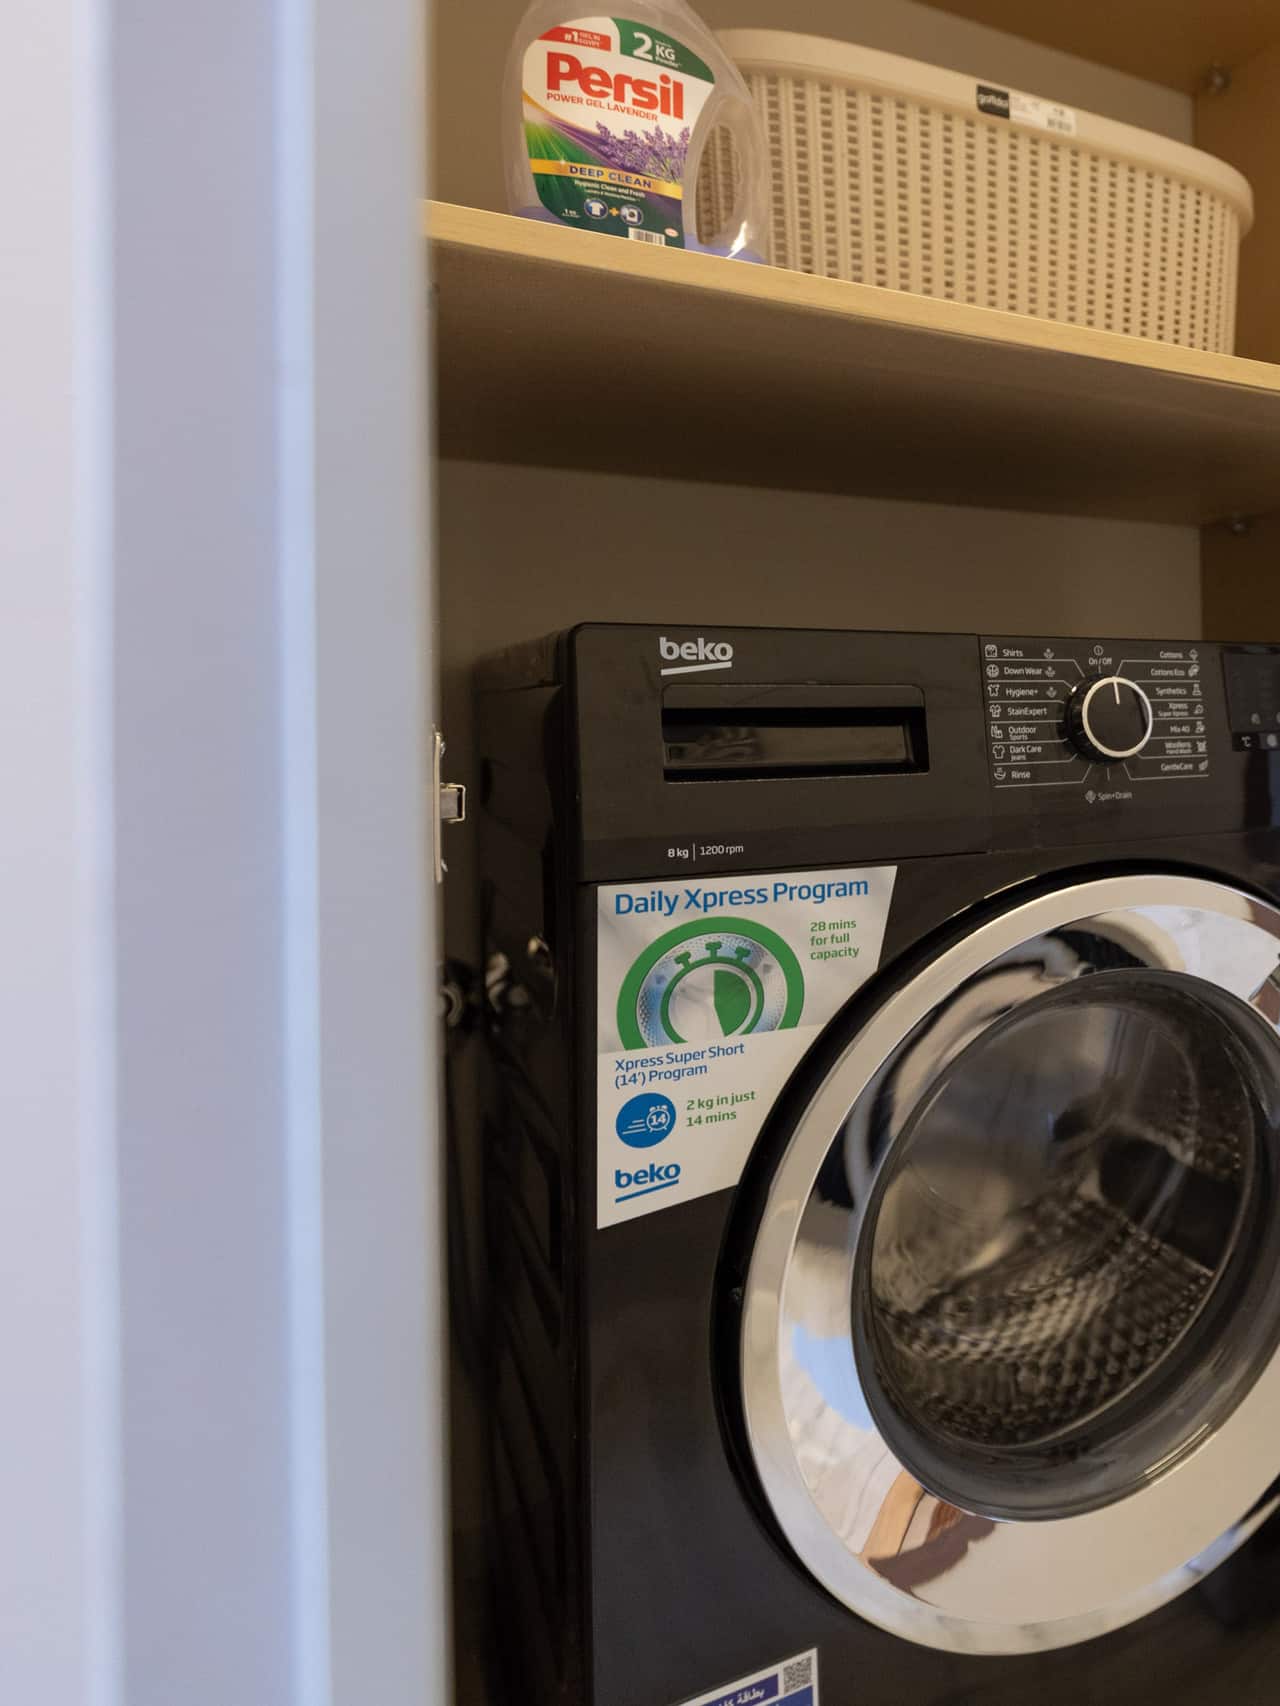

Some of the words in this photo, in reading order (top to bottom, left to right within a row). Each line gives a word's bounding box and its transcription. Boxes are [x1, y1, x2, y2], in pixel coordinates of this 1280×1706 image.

[633, 31, 653, 61] 2
[655, 44, 676, 61] KG
[546, 51, 684, 120] Persil
[546, 92, 584, 105] POWER
[586, 98, 605, 110] GEL
[607, 103, 658, 122] LAVENDER
[569, 165, 605, 178] DEEP
[608, 172, 652, 189] CLEAN
[659, 637, 734, 661] beko
[1002, 648, 1024, 657] Shirts
[1160, 650, 1183, 659] Cottons
[1102, 657, 1112, 665] Off
[1003, 666, 1024, 675] Down
[1024, 666, 1042, 675] Wear
[1005, 688, 1039, 697] Hygiene+
[1155, 687, 1188, 696] Synthetics
[1007, 707, 1048, 717] StainExpert
[1008, 726, 1037, 735] Outdoor
[1009, 745, 1026, 753] Dark
[1026, 745, 1042, 753] Care
[1011, 770, 1031, 779] Rinse
[667, 848, 676, 858] 8
[676, 847, 689, 860] kg
[700, 844, 725, 856] 1200
[725, 844, 744, 855] rpm
[615, 889, 680, 917] Daily
[684, 884, 769, 912] Xpress
[773, 879, 869, 905] Program
[810, 921, 826, 932] 28
[828, 919, 857, 931] mins
[810, 934, 829, 947] for
[830, 932, 850, 945] full
[810, 946, 860, 962] capacity
[614, 1055, 664, 1072] Xpress
[665, 1048, 707, 1067] Super
[708, 1042, 745, 1059] Short
[648, 1063, 708, 1084] Program
[686, 1100, 696, 1111] 2
[697, 1097, 714, 1111] kg
[715, 1094, 728, 1106] in
[729, 1090, 756, 1106] just
[650, 1112, 666, 1126] 14
[686, 1114, 703, 1127] 14
[704, 1109, 737, 1125] mins
[614, 1162, 682, 1190] beko
